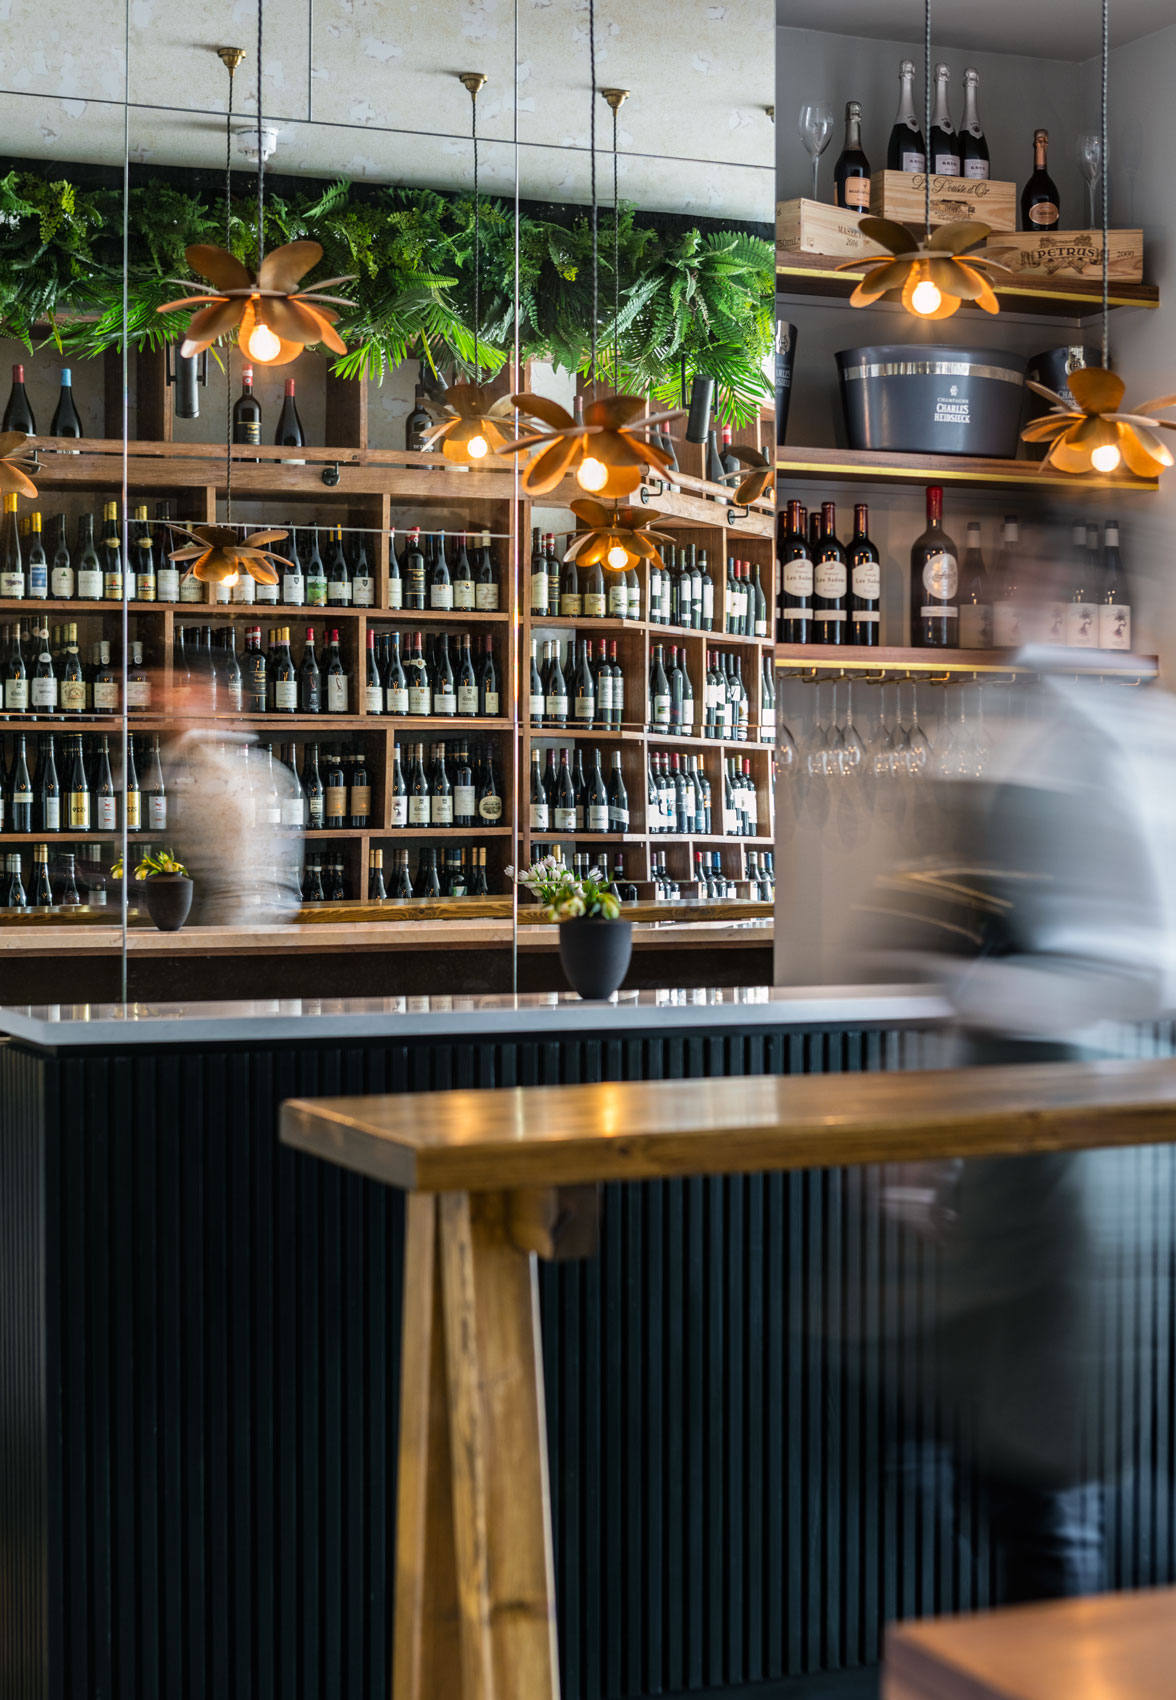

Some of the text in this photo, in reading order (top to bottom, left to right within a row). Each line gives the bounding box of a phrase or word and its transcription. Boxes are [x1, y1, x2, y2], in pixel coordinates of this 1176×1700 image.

[912, 174, 927, 191] L
[1037, 247, 1095, 259] PETRUS
[1116, 250, 1134, 258] 2000
[936, 403, 969, 415] CHARLES
[934, 413, 970, 424] HEIDSIECK
